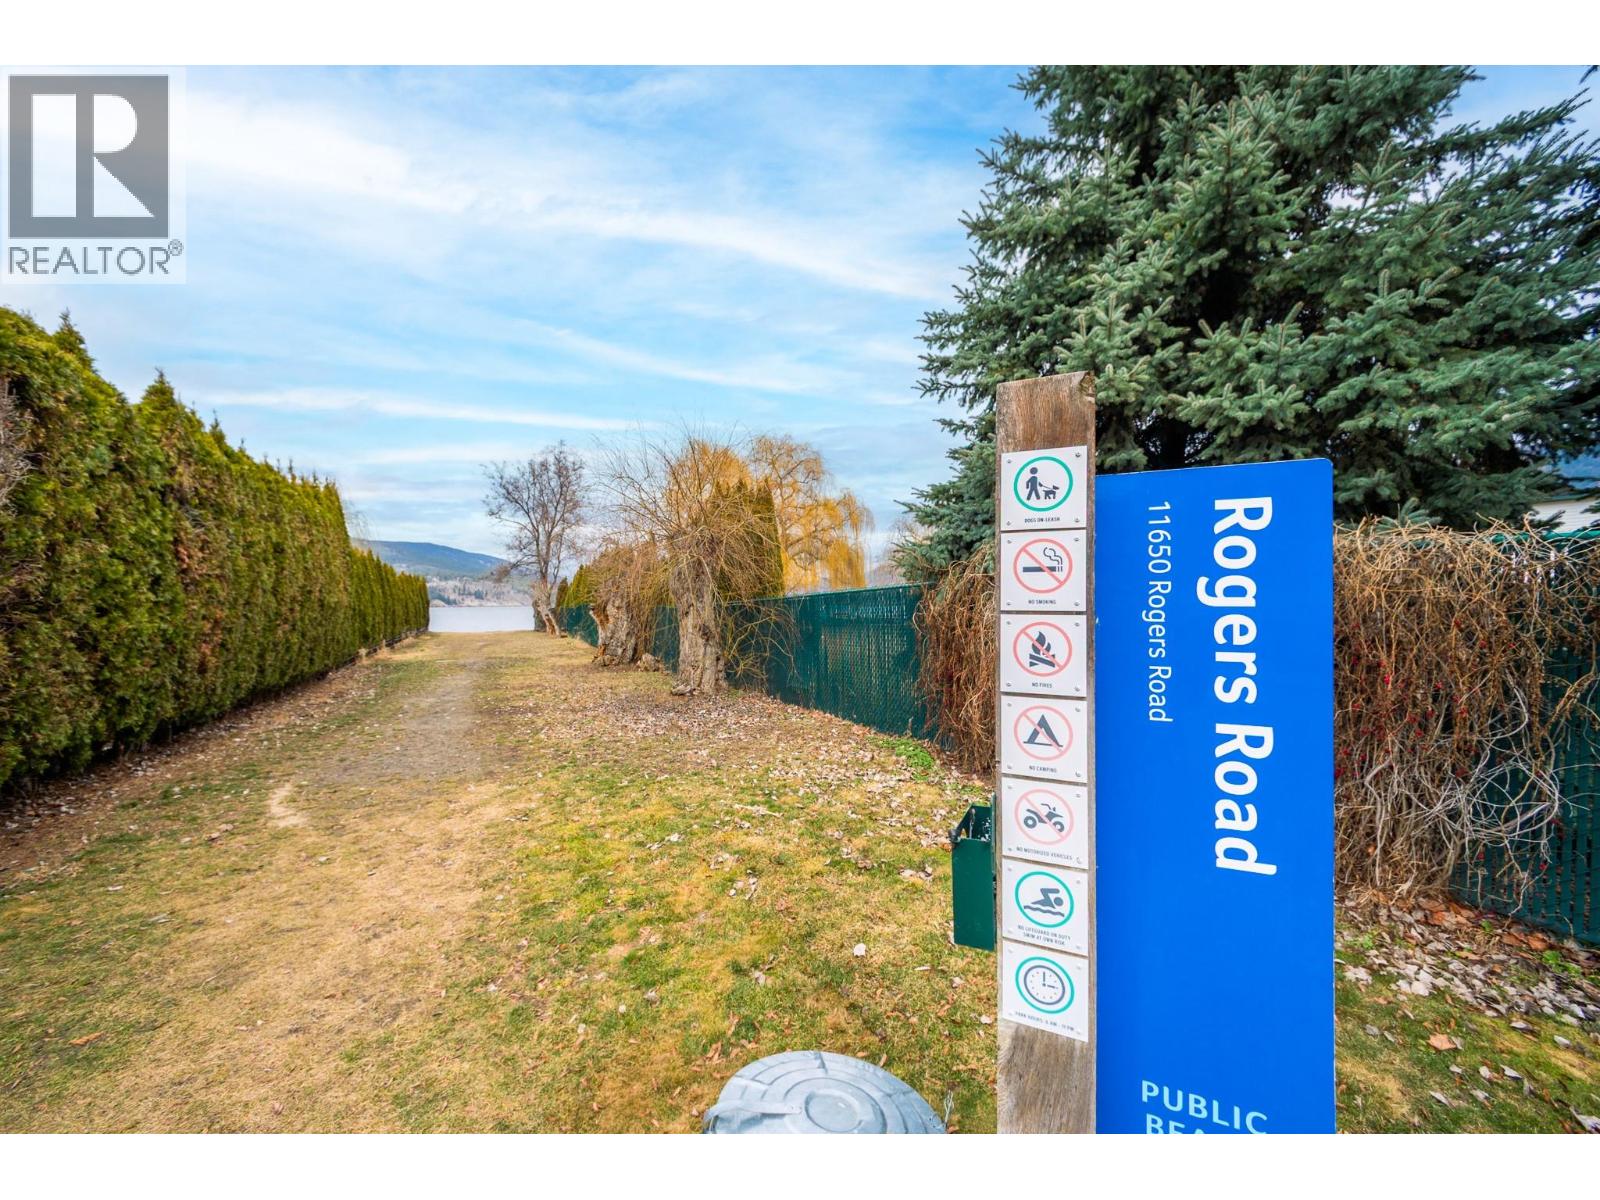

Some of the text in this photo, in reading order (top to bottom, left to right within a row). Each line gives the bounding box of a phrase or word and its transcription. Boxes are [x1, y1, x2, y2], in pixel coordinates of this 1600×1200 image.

[1141, 501, 1174, 723] 11650 Rogers Road
[1196, 496, 1278, 876] Rogers Road
[1142, 1080, 1267, 1134] PUBLIC
[1146, 1113, 1206, 1134] BE
